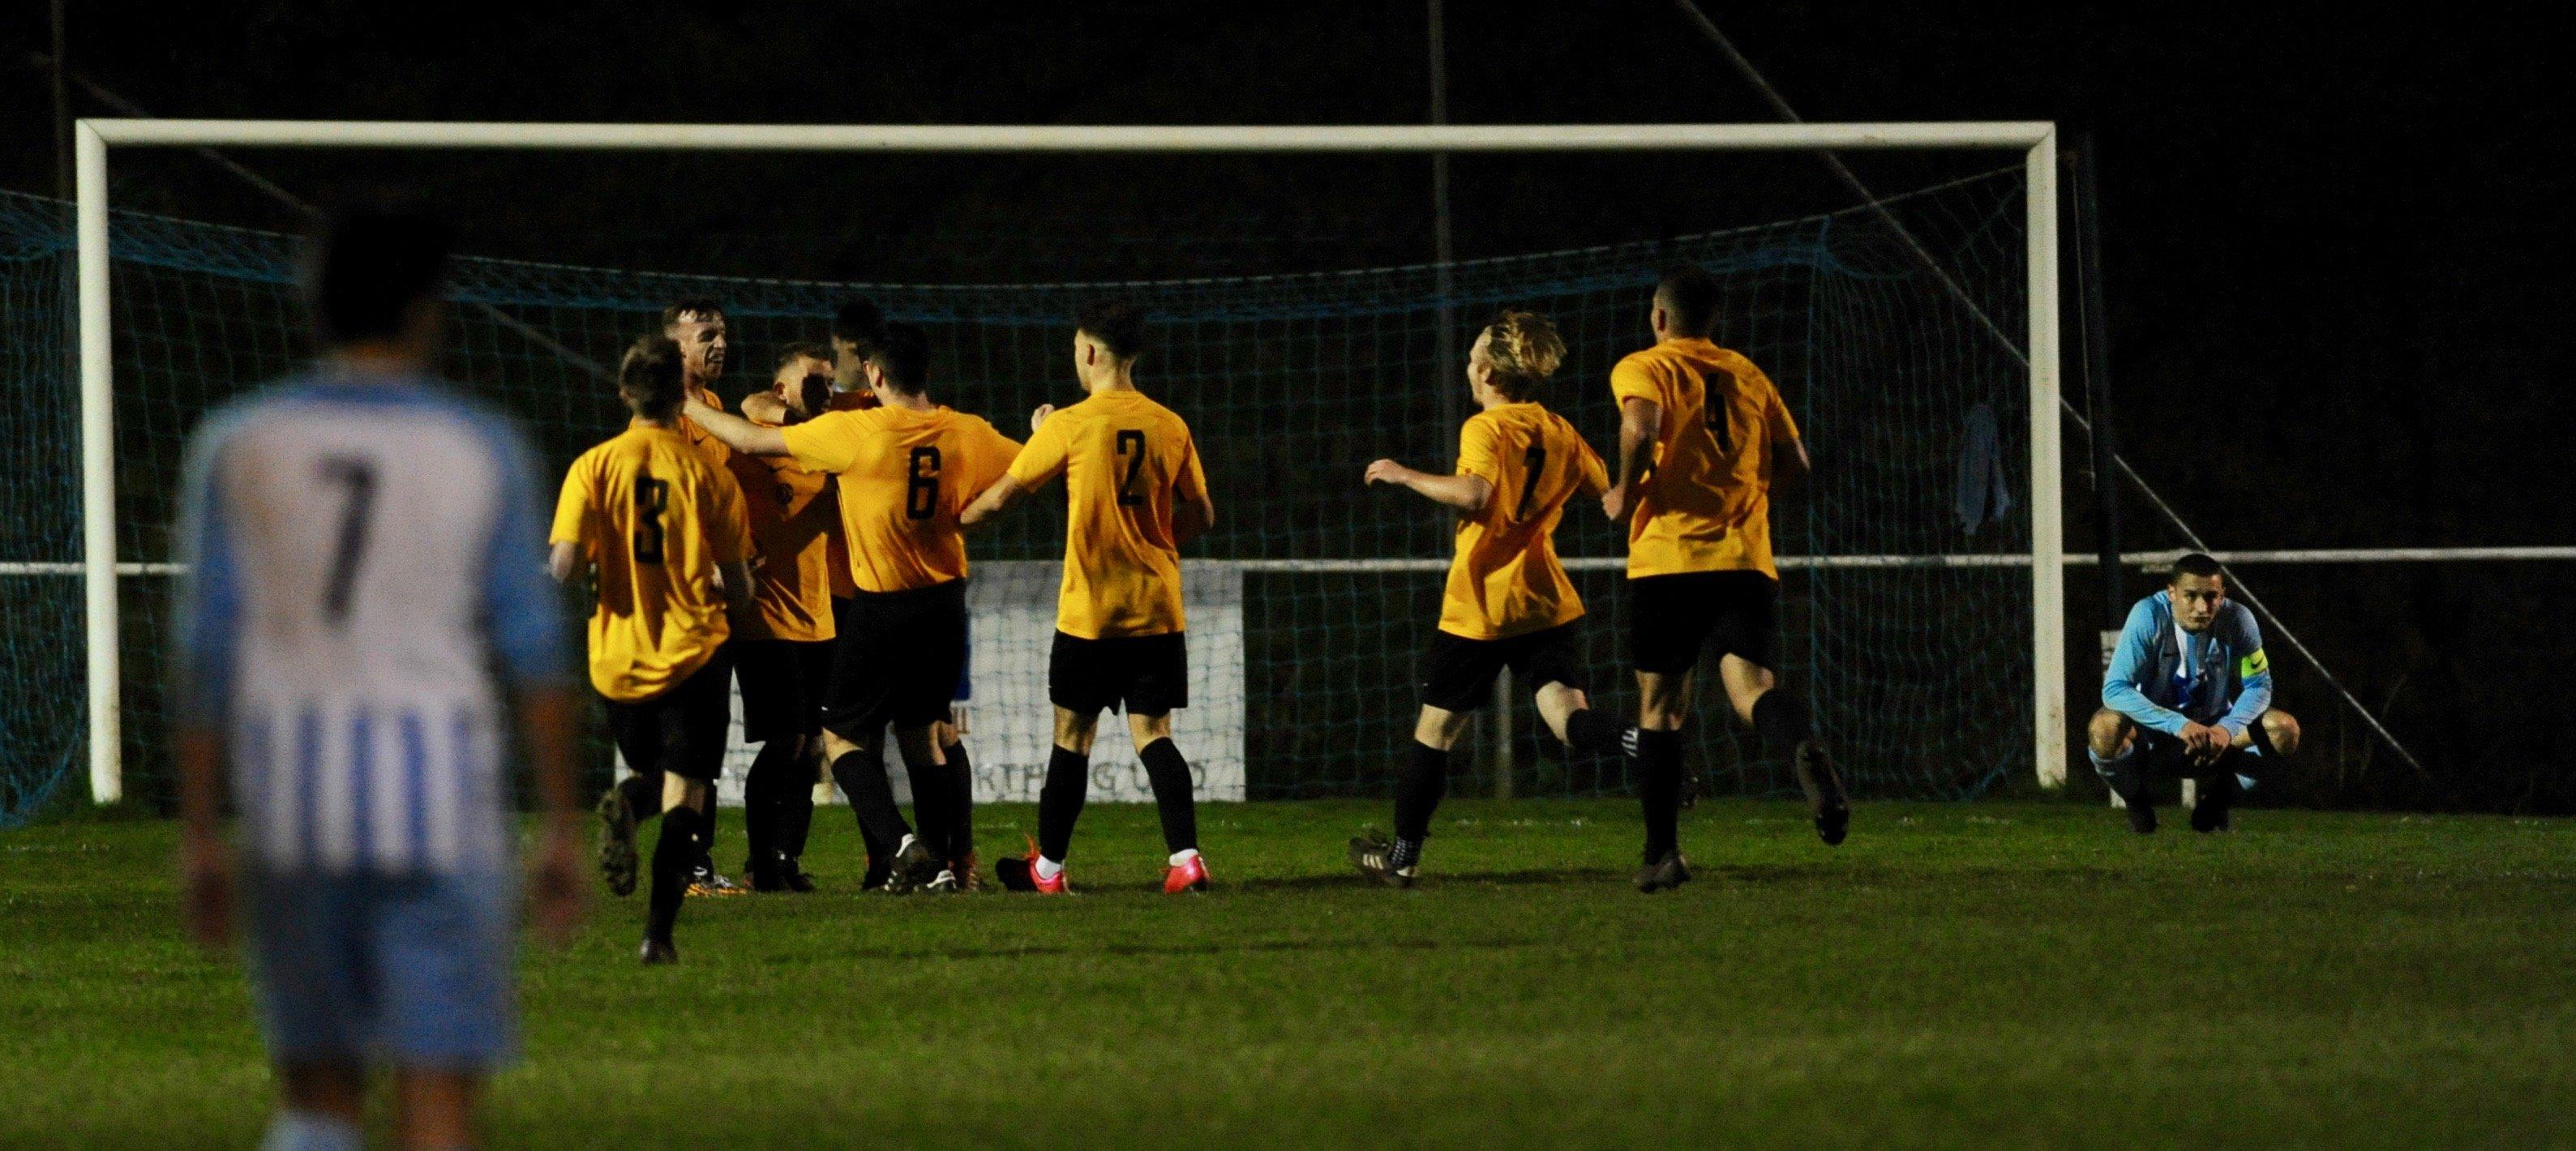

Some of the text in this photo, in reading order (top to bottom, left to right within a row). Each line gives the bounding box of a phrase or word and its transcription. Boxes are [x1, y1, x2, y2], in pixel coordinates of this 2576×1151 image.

[1705, 372, 1729, 451] 4
[907, 447, 940, 519] 6
[1117, 429, 1145, 504] 2
[1515, 447, 1546, 521] 7
[315, 456, 377, 627] 7
[636, 477, 668, 563] 3
